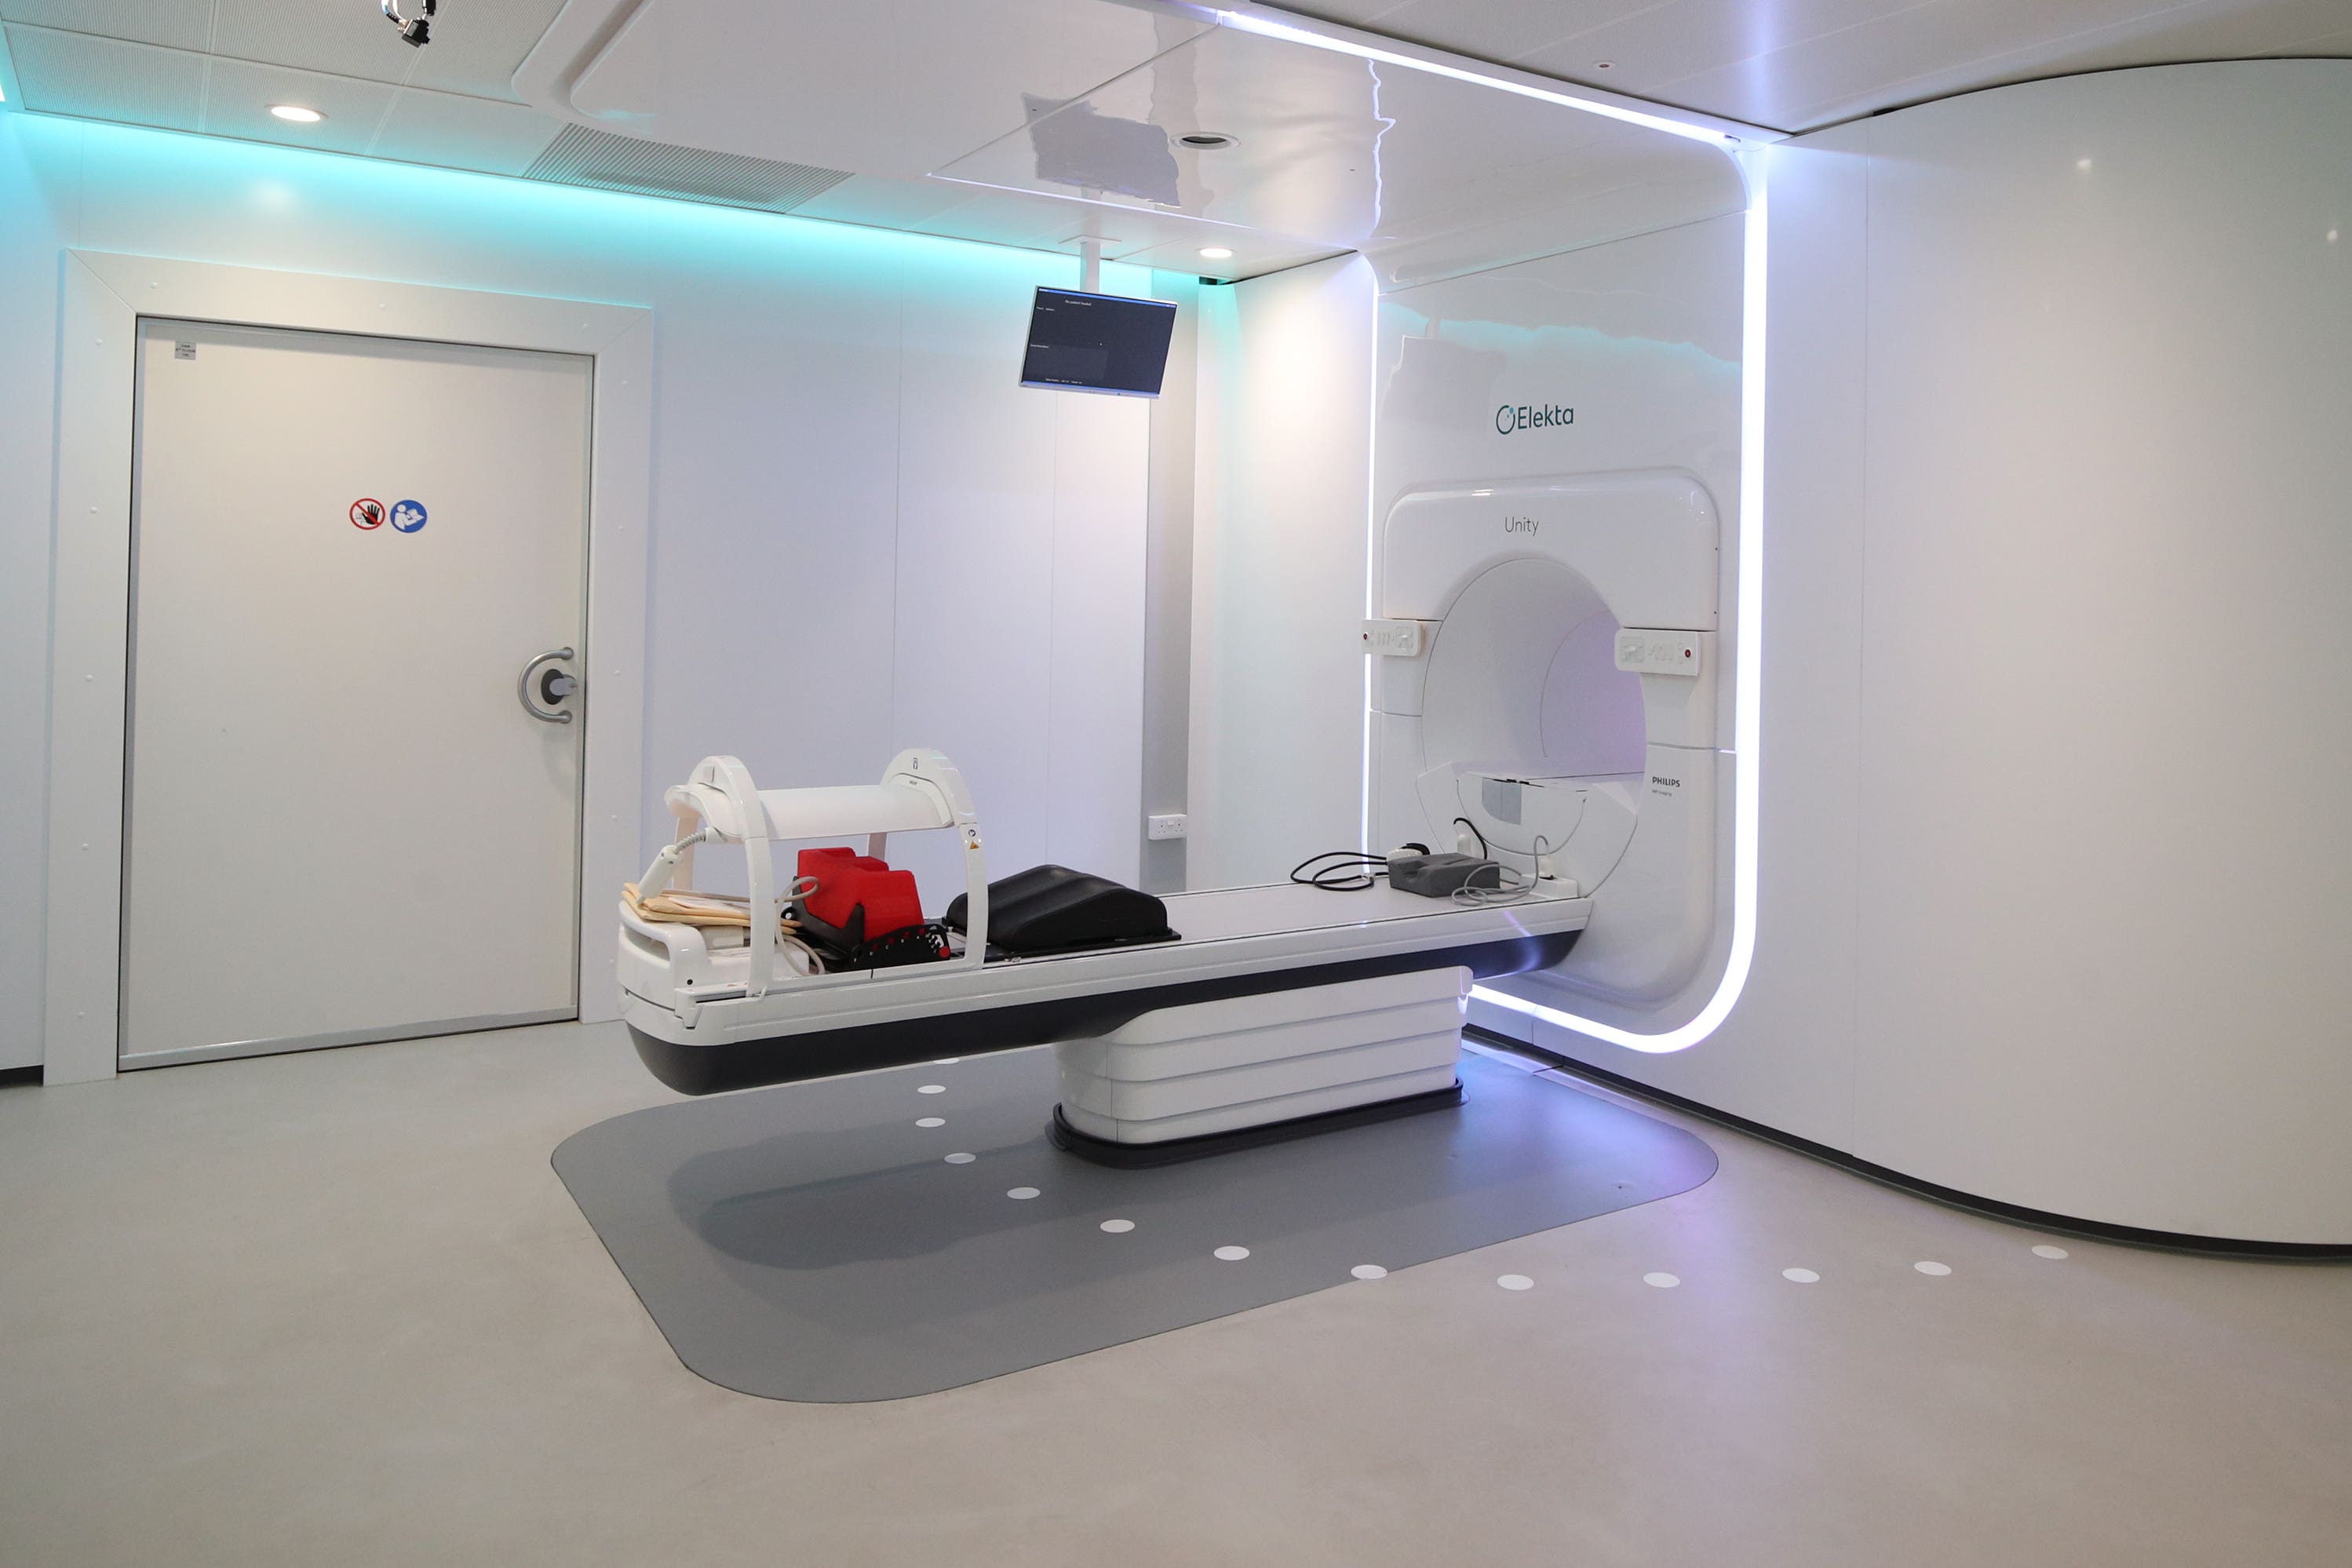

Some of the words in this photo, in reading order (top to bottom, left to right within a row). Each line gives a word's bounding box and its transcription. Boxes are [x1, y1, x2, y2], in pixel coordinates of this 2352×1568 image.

[1517, 403, 1574, 430] Elekta
[1504, 516, 1540, 537] Unity
[1652, 776, 1681, 788] PHILIPS
